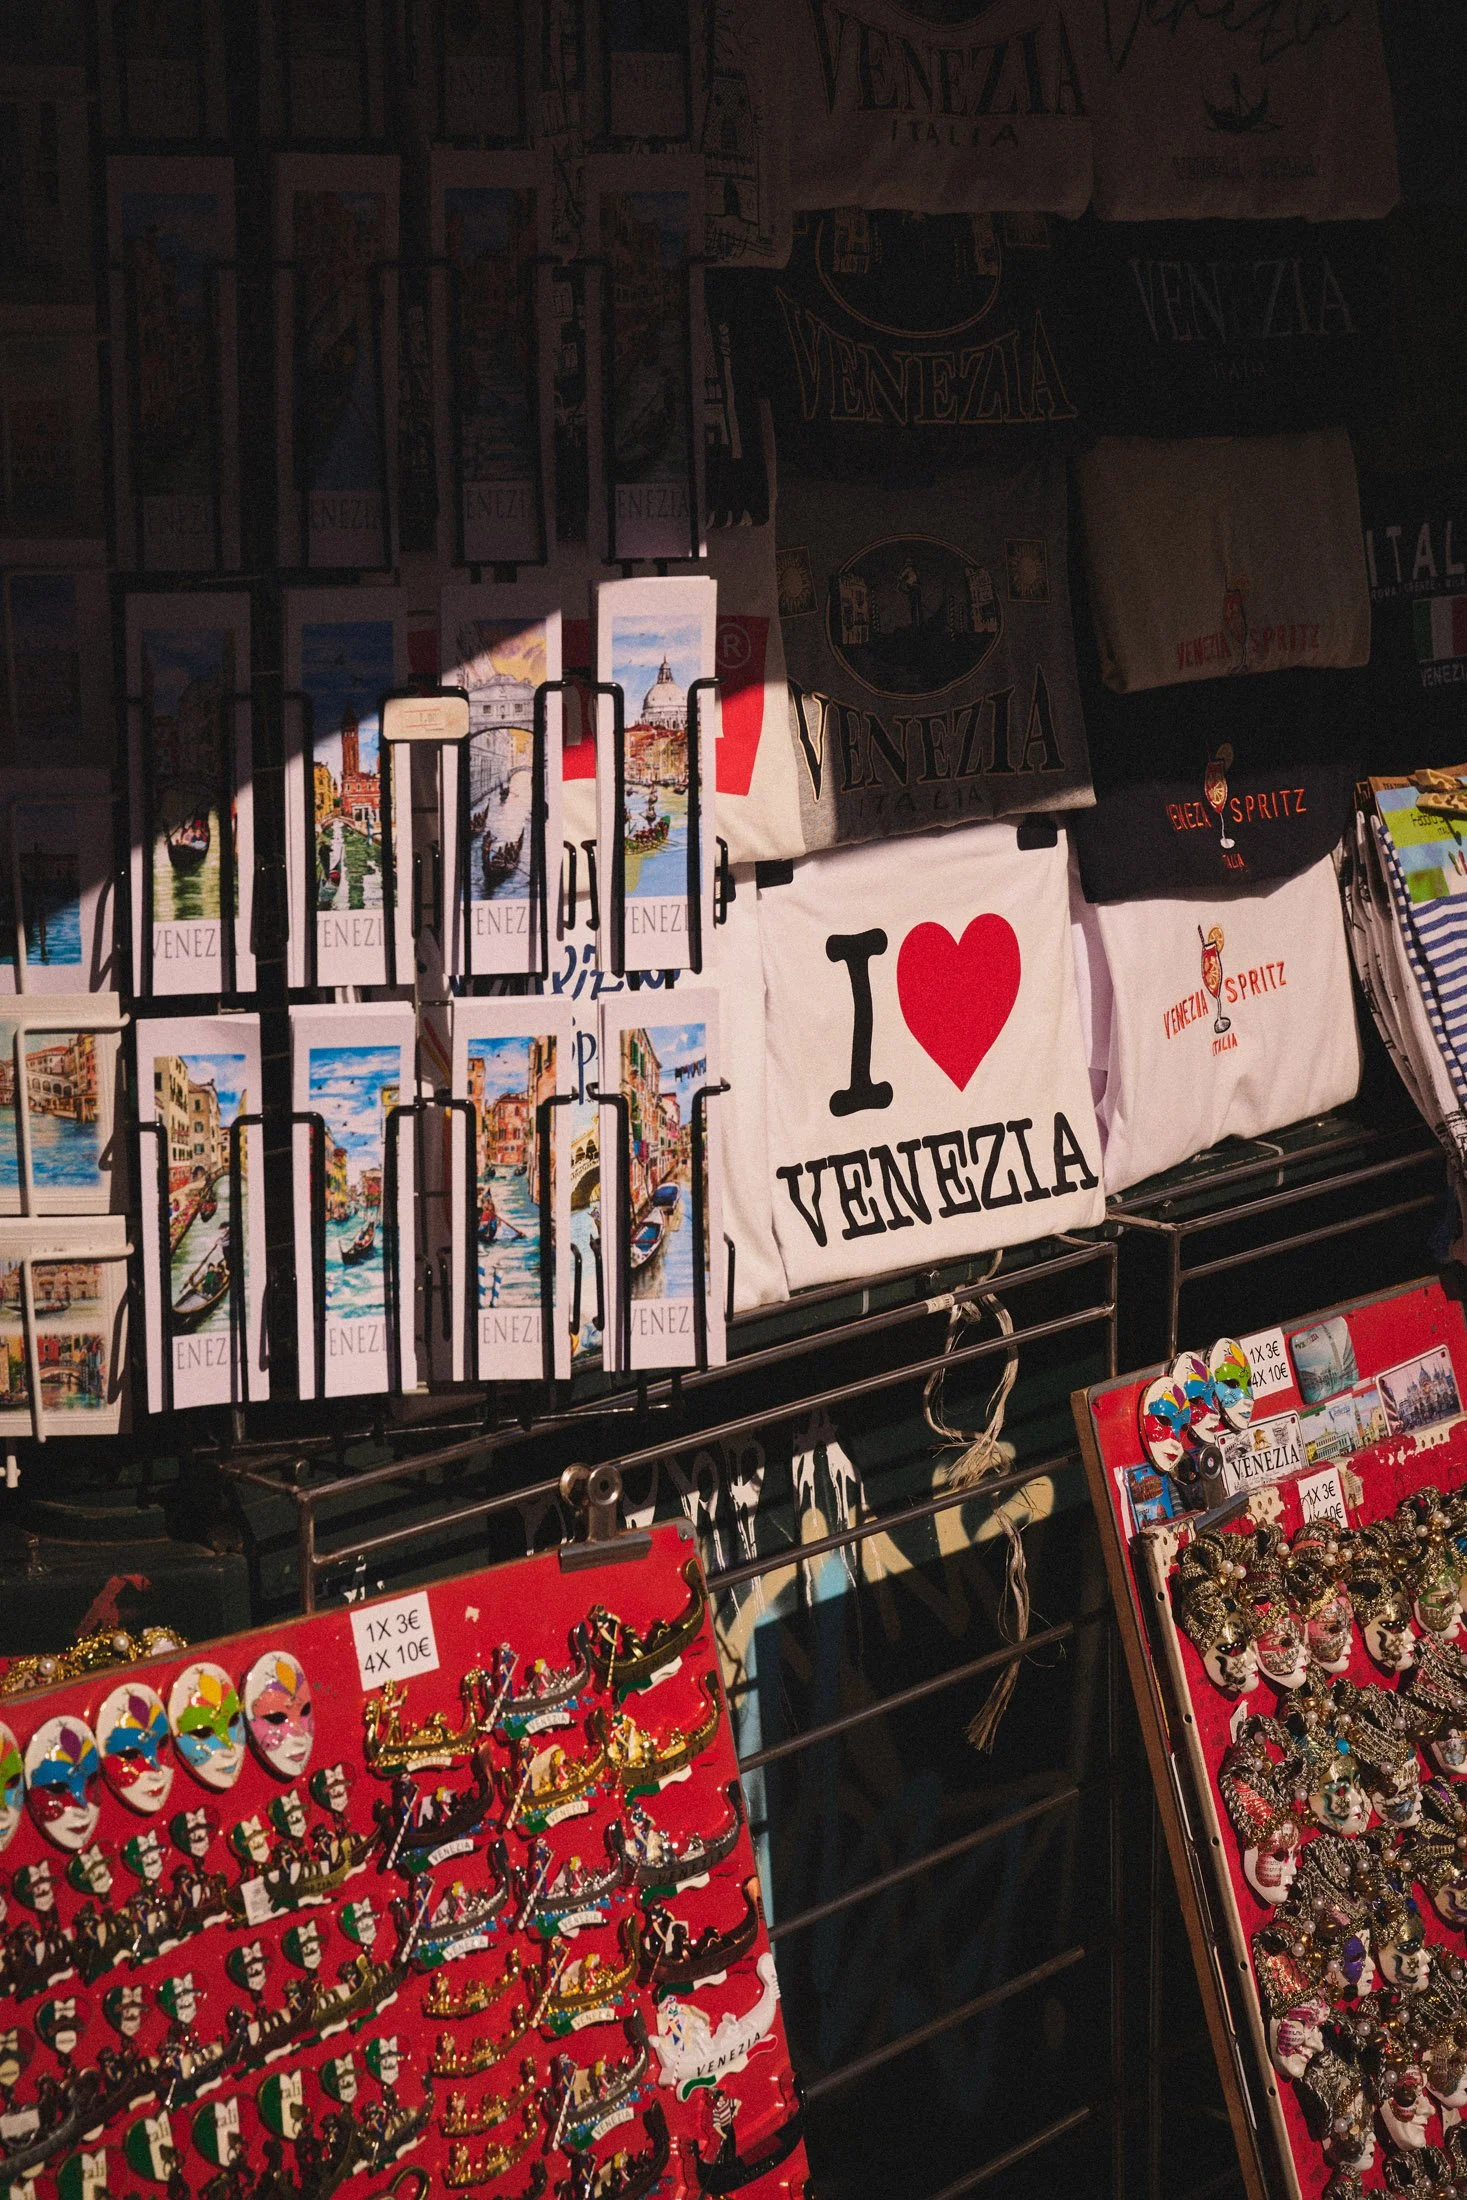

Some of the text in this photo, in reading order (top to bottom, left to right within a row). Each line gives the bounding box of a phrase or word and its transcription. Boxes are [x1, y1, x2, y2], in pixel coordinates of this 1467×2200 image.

[808, 0, 1089, 116] VENEZIA
[889, 118, 1020, 147] ITALIA
[1127, 255, 1360, 343] VENZIA
[775, 286, 1080, 425] VENEZIA
[787, 662, 1067, 803] VENEZIA
[1229, 786, 1309, 825] SPRITZ
[318, 917, 383, 948] ENEZI
[1163, 960, 1287, 1040] VENEZIA SPRITZ
[826, 928, 894, 1117] I
[776, 1111, 1099, 1248] VENEZIA
[482, 1315, 541, 1344] ENEZI
[176, 1338, 227, 1370] ENEZ
[1250, 1340, 1281, 1364] 1X 3€
[1252, 1362, 1288, 1388] 4X 10€
[1231, 1443, 1300, 1481] VENEZIA
[1322, 1480, 1336, 1500] 3€
[366, 1609, 420, 1642] 1X 3€
[364, 1636, 431, 1673] 4X 10€
[433, 1840, 472, 1862] VENEZIA
[696, 2031, 761, 2077] VENEZIA
[596, 2109, 632, 2137] VENEZIA
